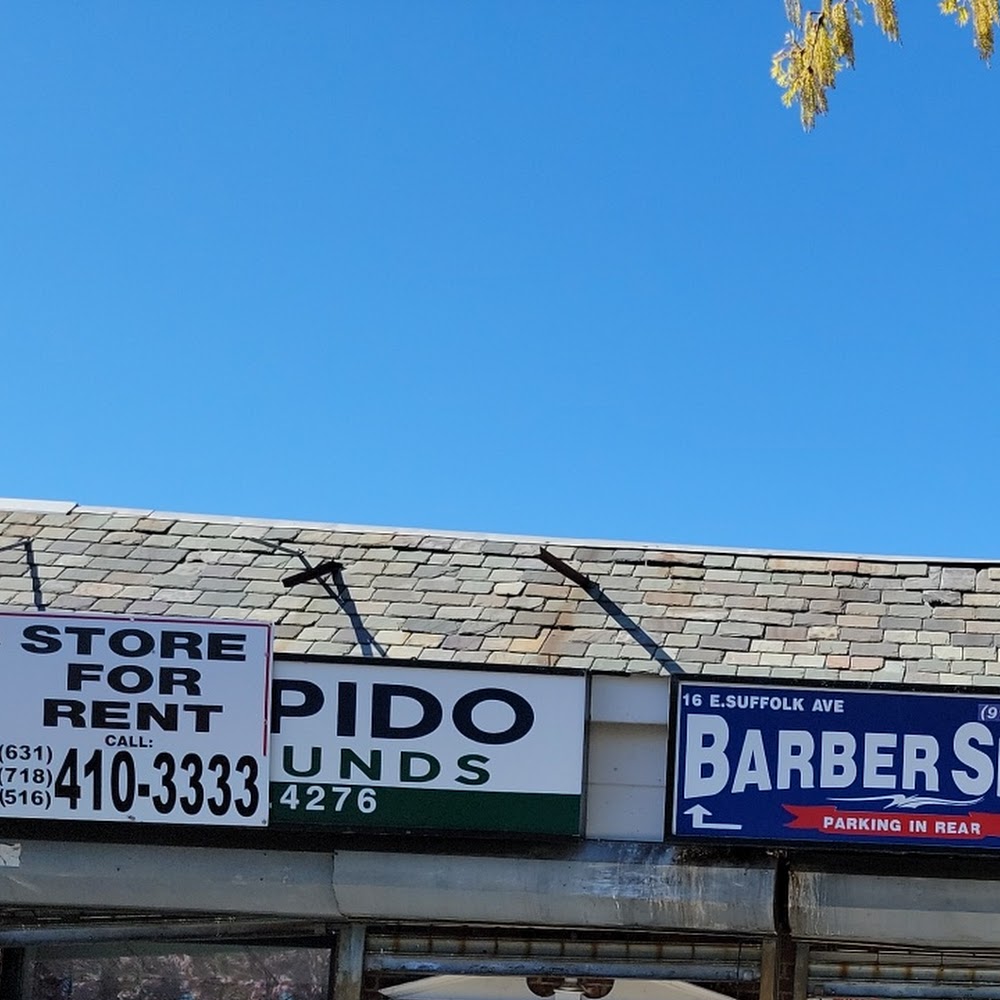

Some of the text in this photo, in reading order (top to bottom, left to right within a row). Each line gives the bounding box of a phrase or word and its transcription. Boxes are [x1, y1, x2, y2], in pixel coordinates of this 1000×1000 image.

[20, 624, 247, 662] STORE
[67, 662, 202, 696] FOR
[43, 698, 223, 733] RENT
[271, 679, 535, 745] PIDO
[682, 693, 844, 713] 16 E.SUFFOLK AVE
[0, 744, 53, 765] (631)
[105, 734, 154, 749] CALL:
[684, 713, 940, 799] BARBER
[0, 767, 53, 788] (718)
[54, 747, 259, 817] 410-3333
[283, 745, 491, 786] UNDS
[0, 788, 51, 810] (516)
[823, 816, 981, 836] PARKING IN REAR
